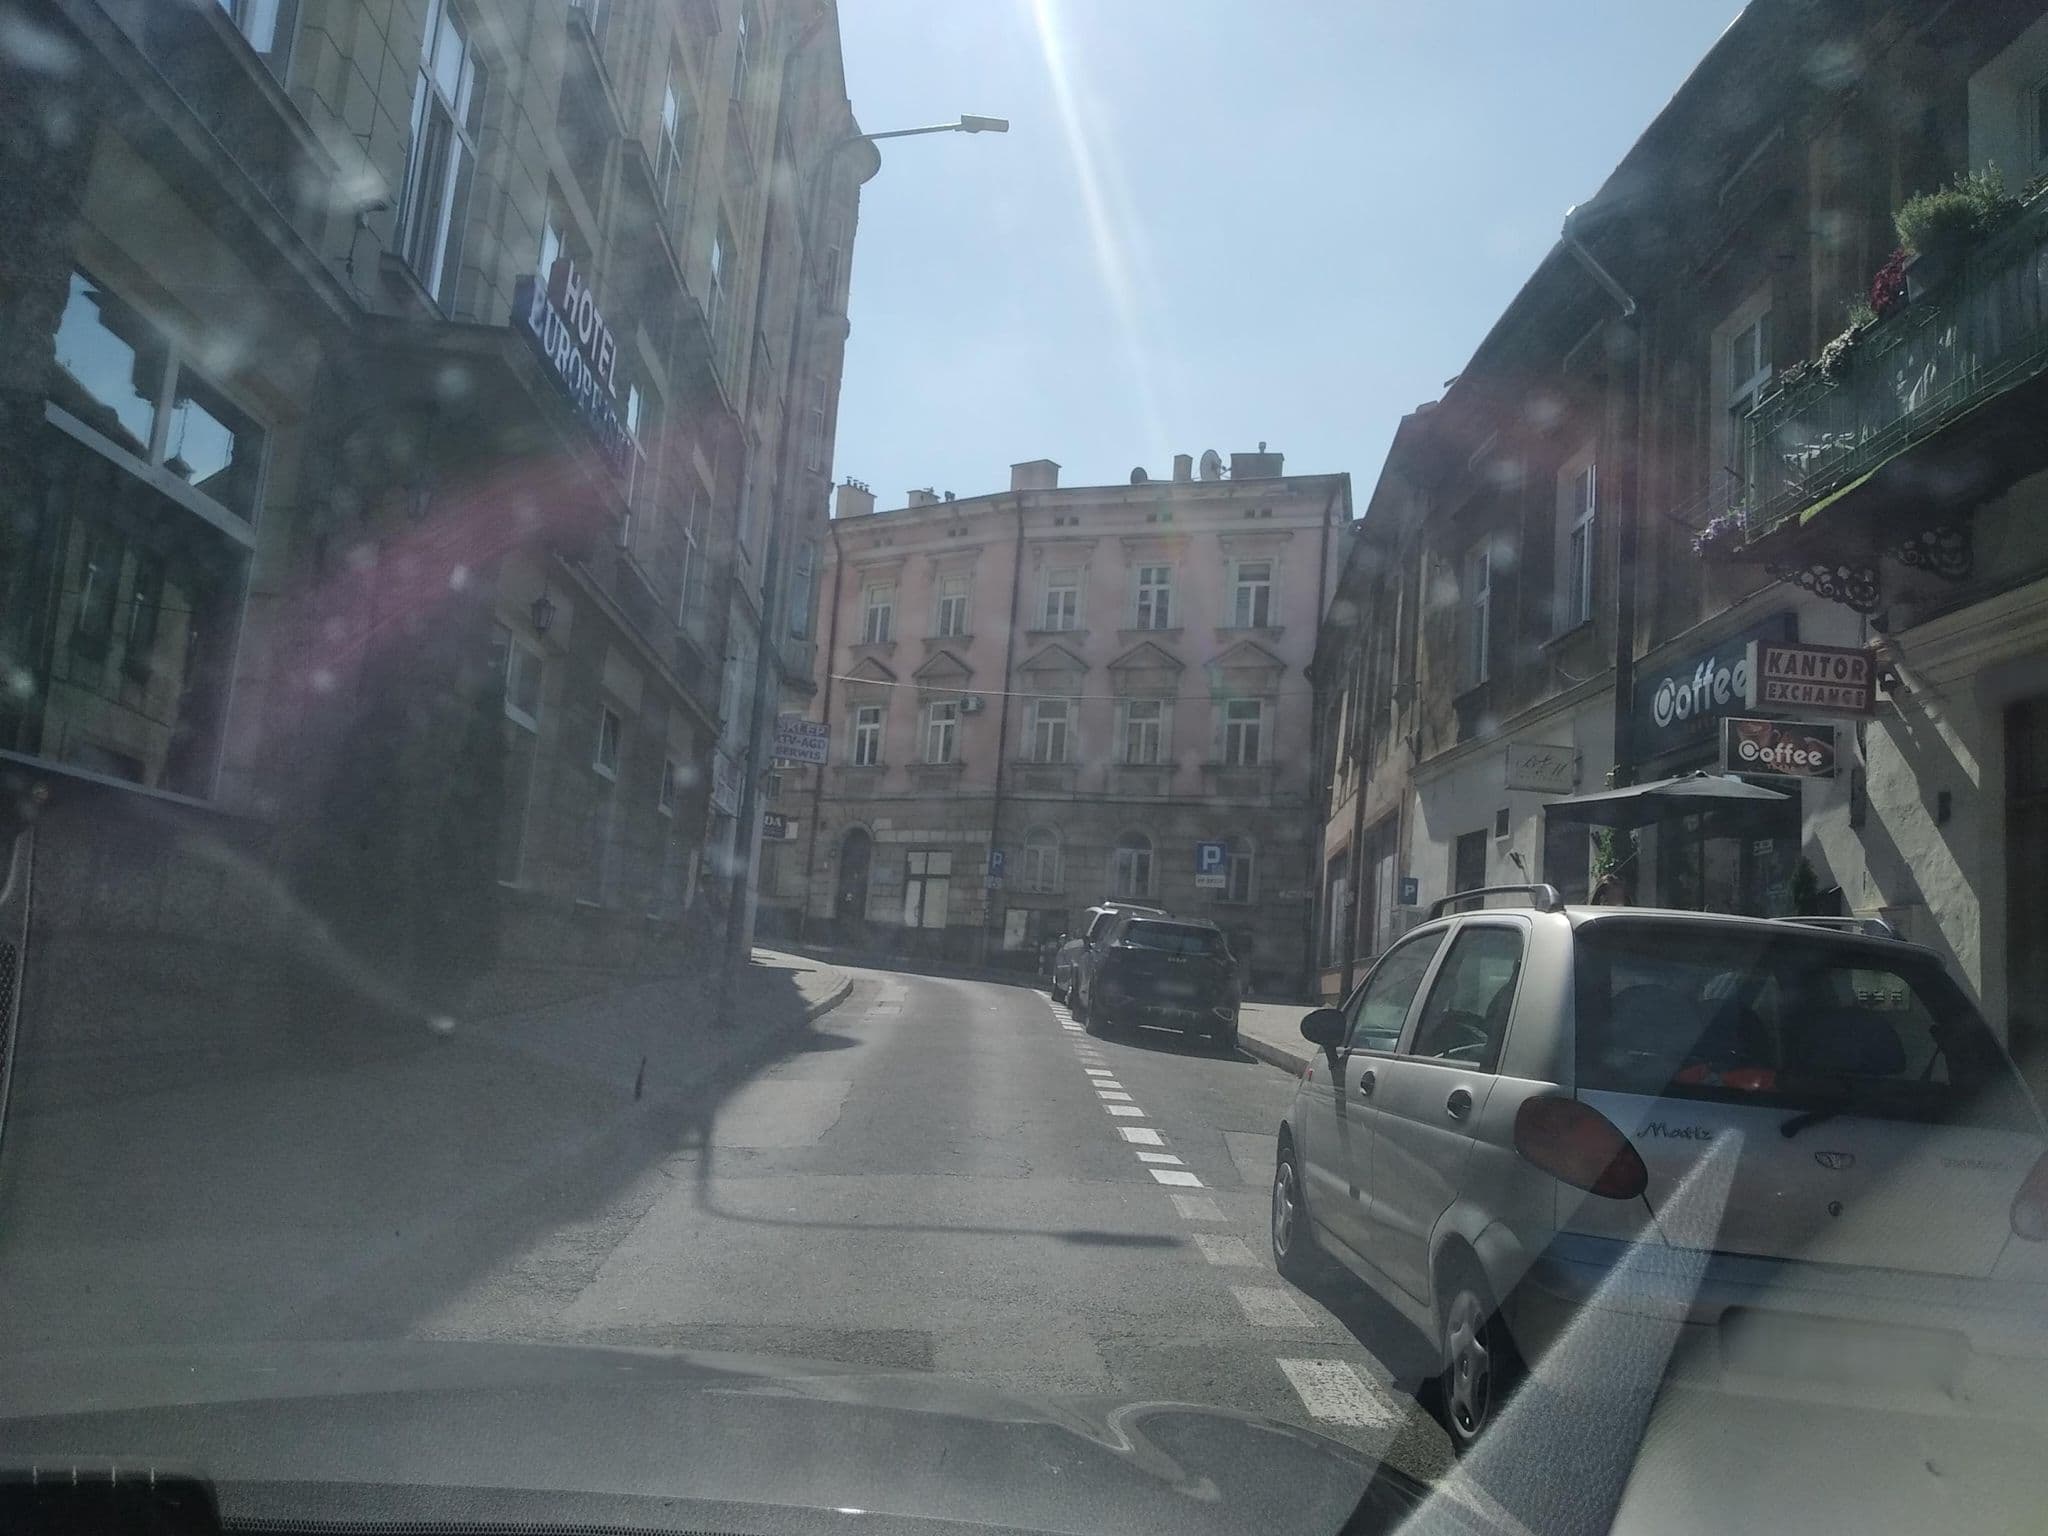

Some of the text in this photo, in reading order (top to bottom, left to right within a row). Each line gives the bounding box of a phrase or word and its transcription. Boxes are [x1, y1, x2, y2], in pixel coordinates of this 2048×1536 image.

[564, 259, 617, 399] HOTEL
[1767, 651, 1865, 681] KANTOR
[1653, 656, 1747, 728] Coffee
[1768, 683, 1864, 706] EXCHANGE
[1738, 739, 1822, 766] Coffee
[992, 852, 1002, 869] P
[1203, 846, 1221, 870] P
